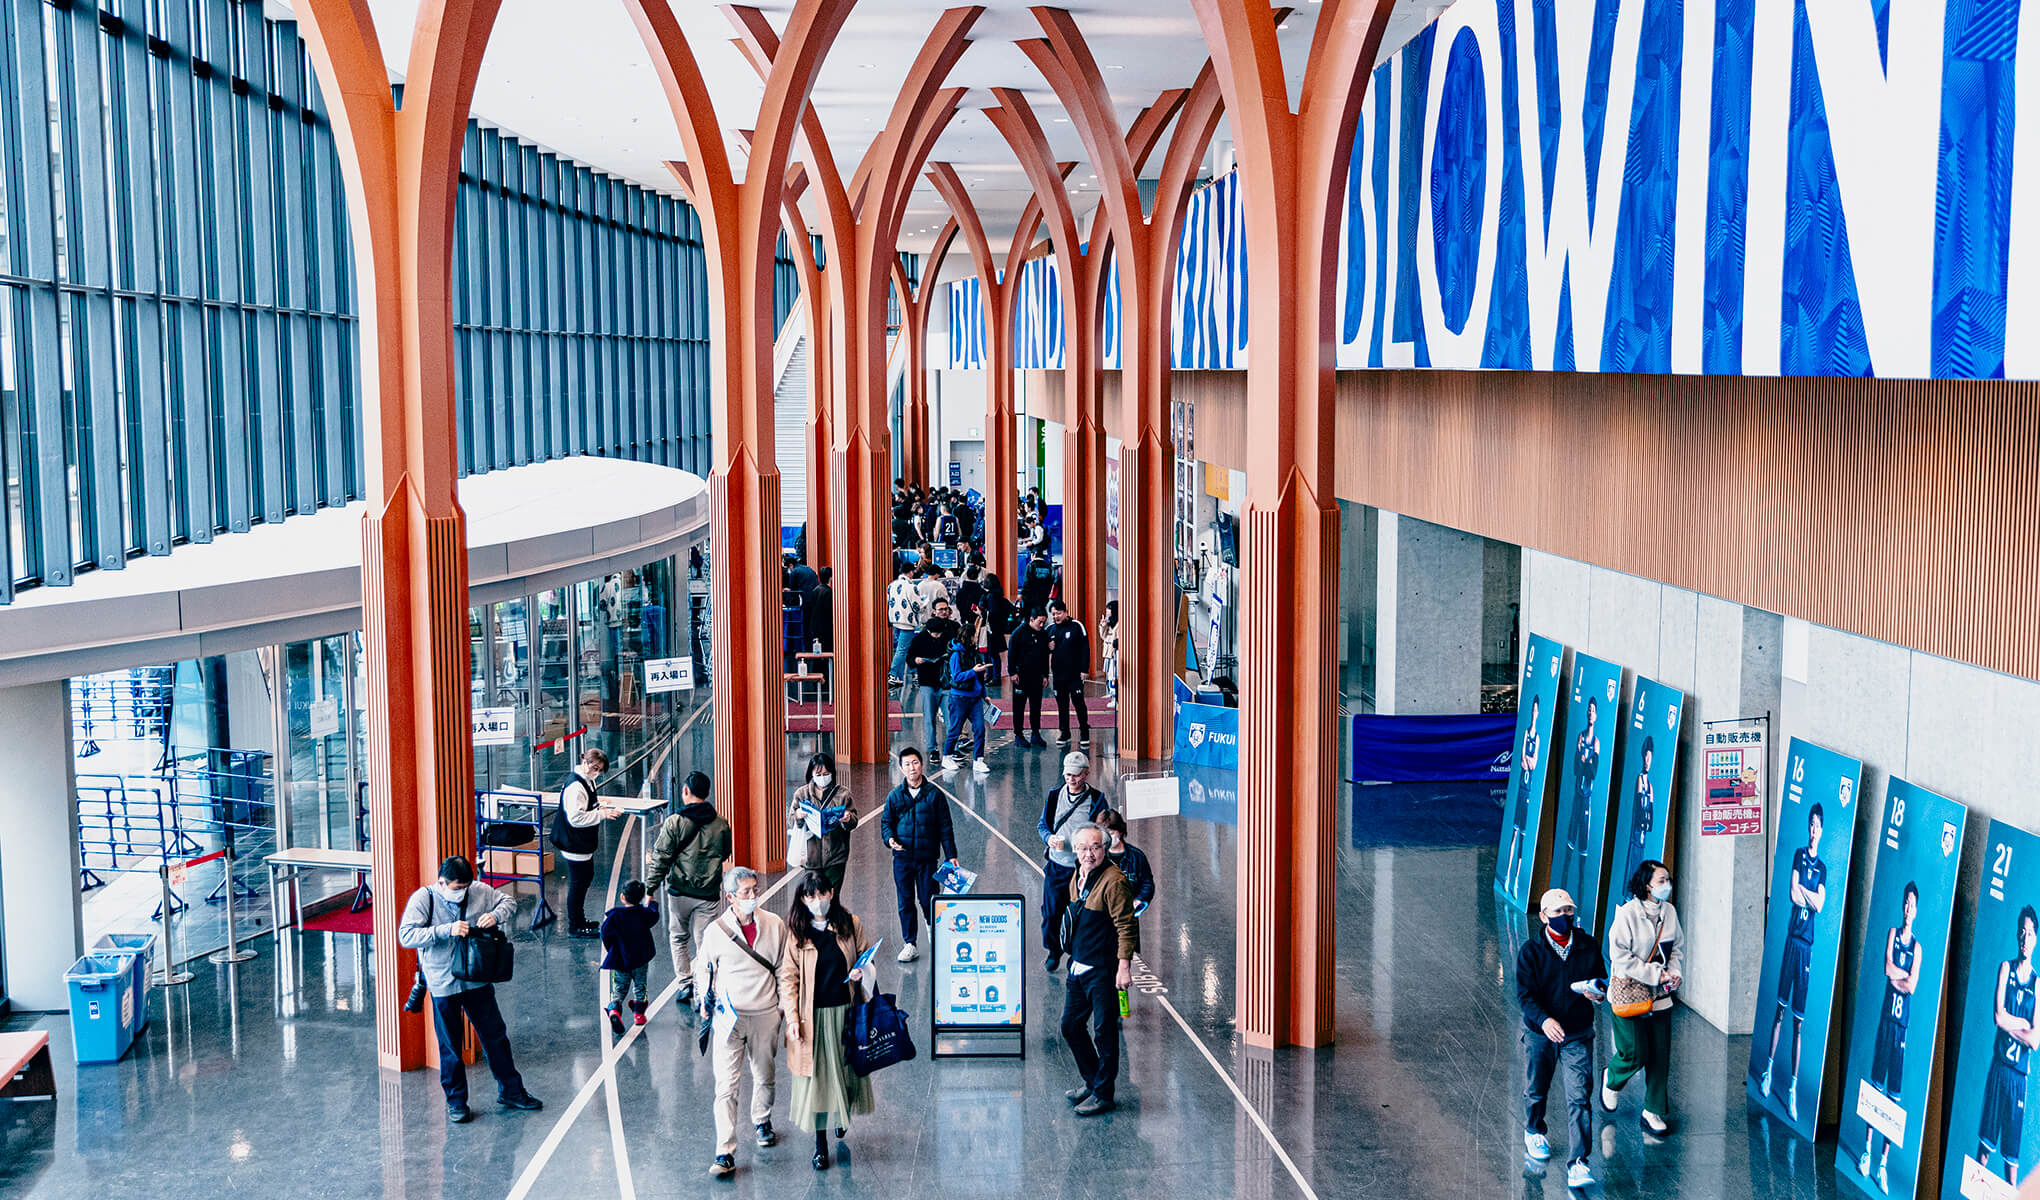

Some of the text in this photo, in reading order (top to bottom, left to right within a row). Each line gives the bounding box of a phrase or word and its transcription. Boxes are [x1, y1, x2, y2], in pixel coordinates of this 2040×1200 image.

[945, 522, 955, 532] 21
[1528, 645, 1536, 663] 0
[650, 669, 689, 682] 再入場口
[1638, 690, 1646, 712] 6
[1208, 731, 1236, 746] FUKUI
[1705, 731, 1762, 745] 自動販売機
[1791, 756, 1805, 782] 16
[1702, 809, 1761, 820] 自動販売機は
[1890, 796, 1906, 827] 18
[1729, 822, 1760, 834] コチラ
[1992, 843, 2013, 877] 21
[979, 915, 991, 924] NEW
[1131, 974, 1169, 994] SUB
[1891, 993, 1904, 1019] 18
[2005, 1037, 2021, 1063] 21
